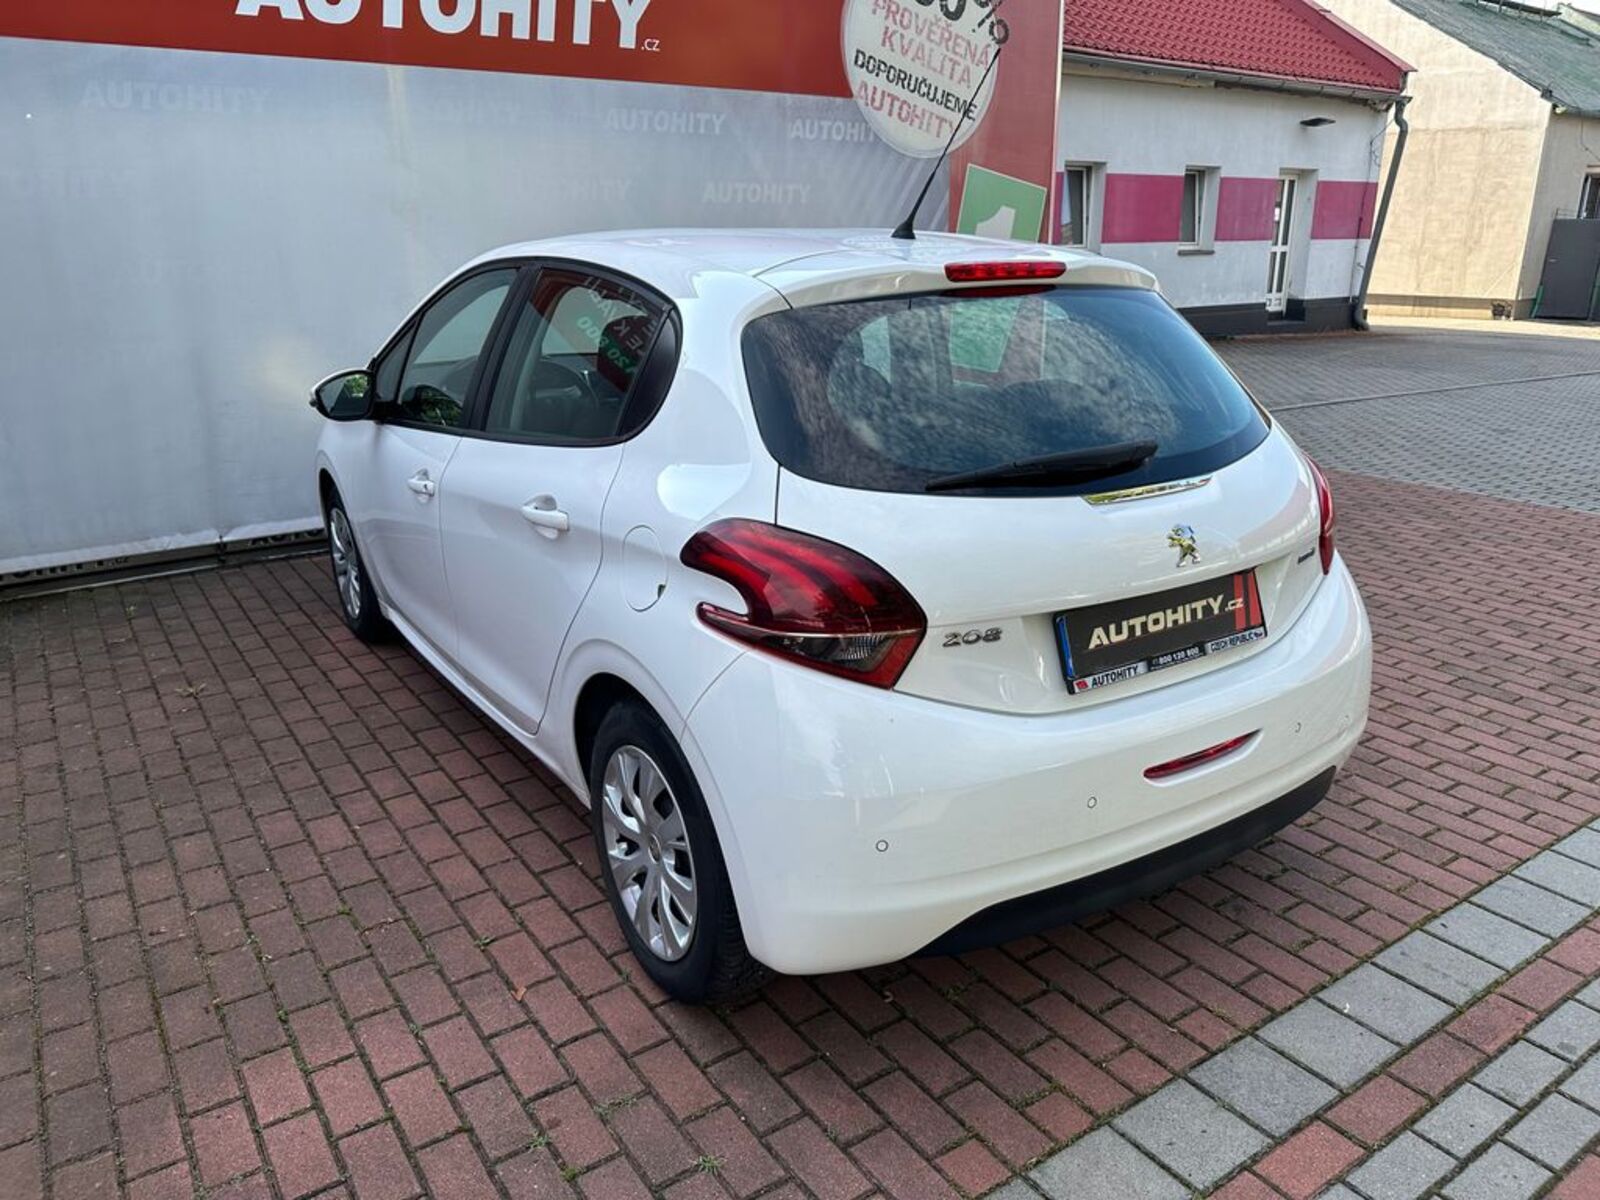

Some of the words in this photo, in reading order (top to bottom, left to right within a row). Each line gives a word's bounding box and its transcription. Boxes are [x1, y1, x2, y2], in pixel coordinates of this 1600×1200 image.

[880, 26, 972, 89] KVALITA
[80, 80, 273, 113] AUTOHITY
[853, 48, 978, 122] DOPORUČUJEME
[604, 107, 727, 136] AUTOHITY
[790, 117, 875, 142] AUTOHIT
[702, 180, 812, 206] AUTOHITY
[942, 627, 1003, 648] 208
[1091, 666, 1140, 689] AUTOHITY
